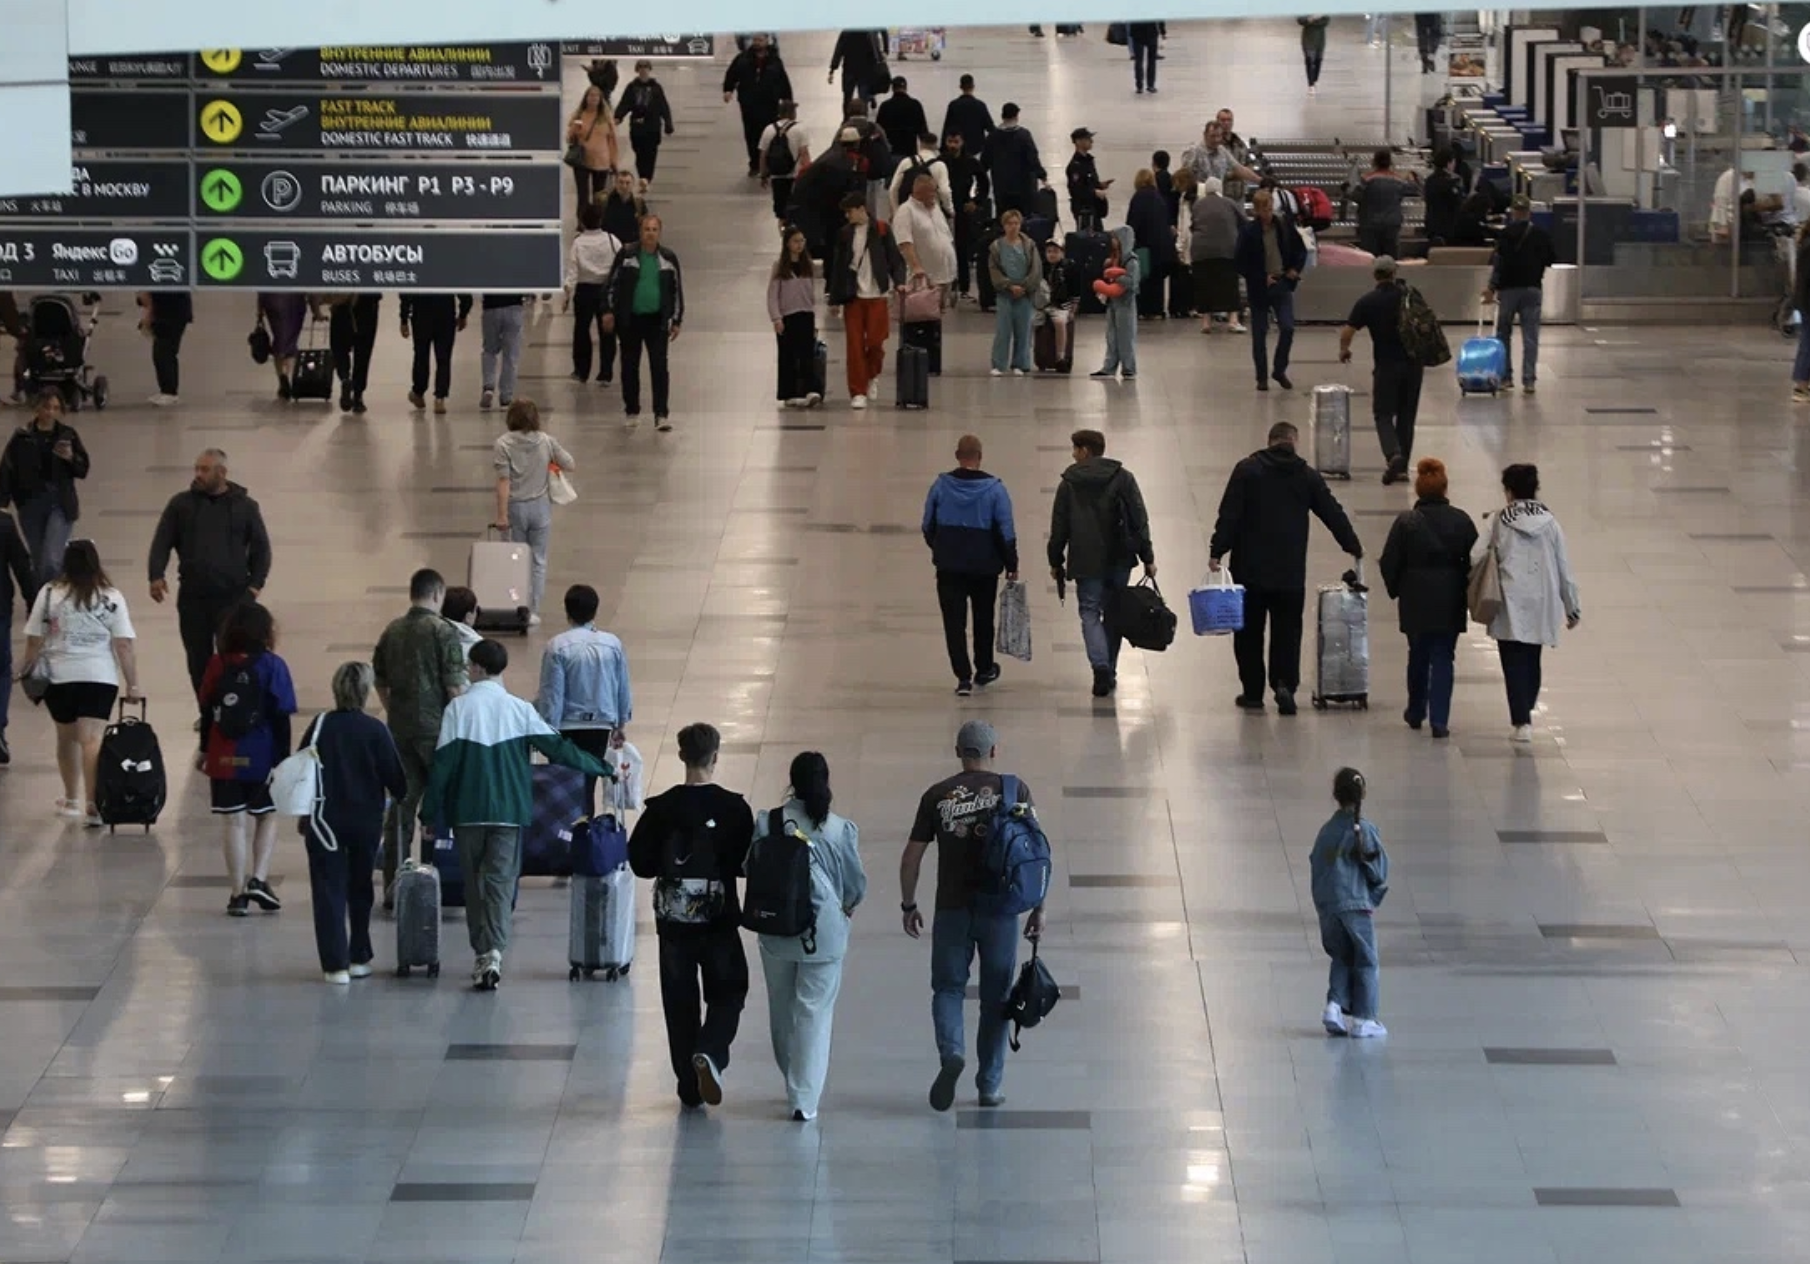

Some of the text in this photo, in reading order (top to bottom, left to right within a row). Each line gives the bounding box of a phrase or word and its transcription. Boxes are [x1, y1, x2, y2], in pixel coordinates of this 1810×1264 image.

[320, 46, 490, 62] ВНУТРЕННИЕ АВИАЛИНИИ
[320, 62, 459, 78] DOMESTIC DEPARTURES
[321, 99, 396, 115] FAST TRACK
[321, 115, 491, 131] ВНУТРЕННИЕ АВИАЛИНИИ
[321, 131, 453, 148] DOMESTIC FAST TRACK
[82, 183, 92, 197] В
[94, 182, 150, 198] МОСКВУ
[321, 175, 410, 195] ПАРКИНГ
[321, 201, 373, 215] PARKING
[23, 242, 35, 261] 3
[52, 242, 107, 262] Яндекс
[321, 244, 424, 264] АВТОБУСЫ
[52, 268, 80, 282] TAXI
[321, 269, 361, 283] BUSES
